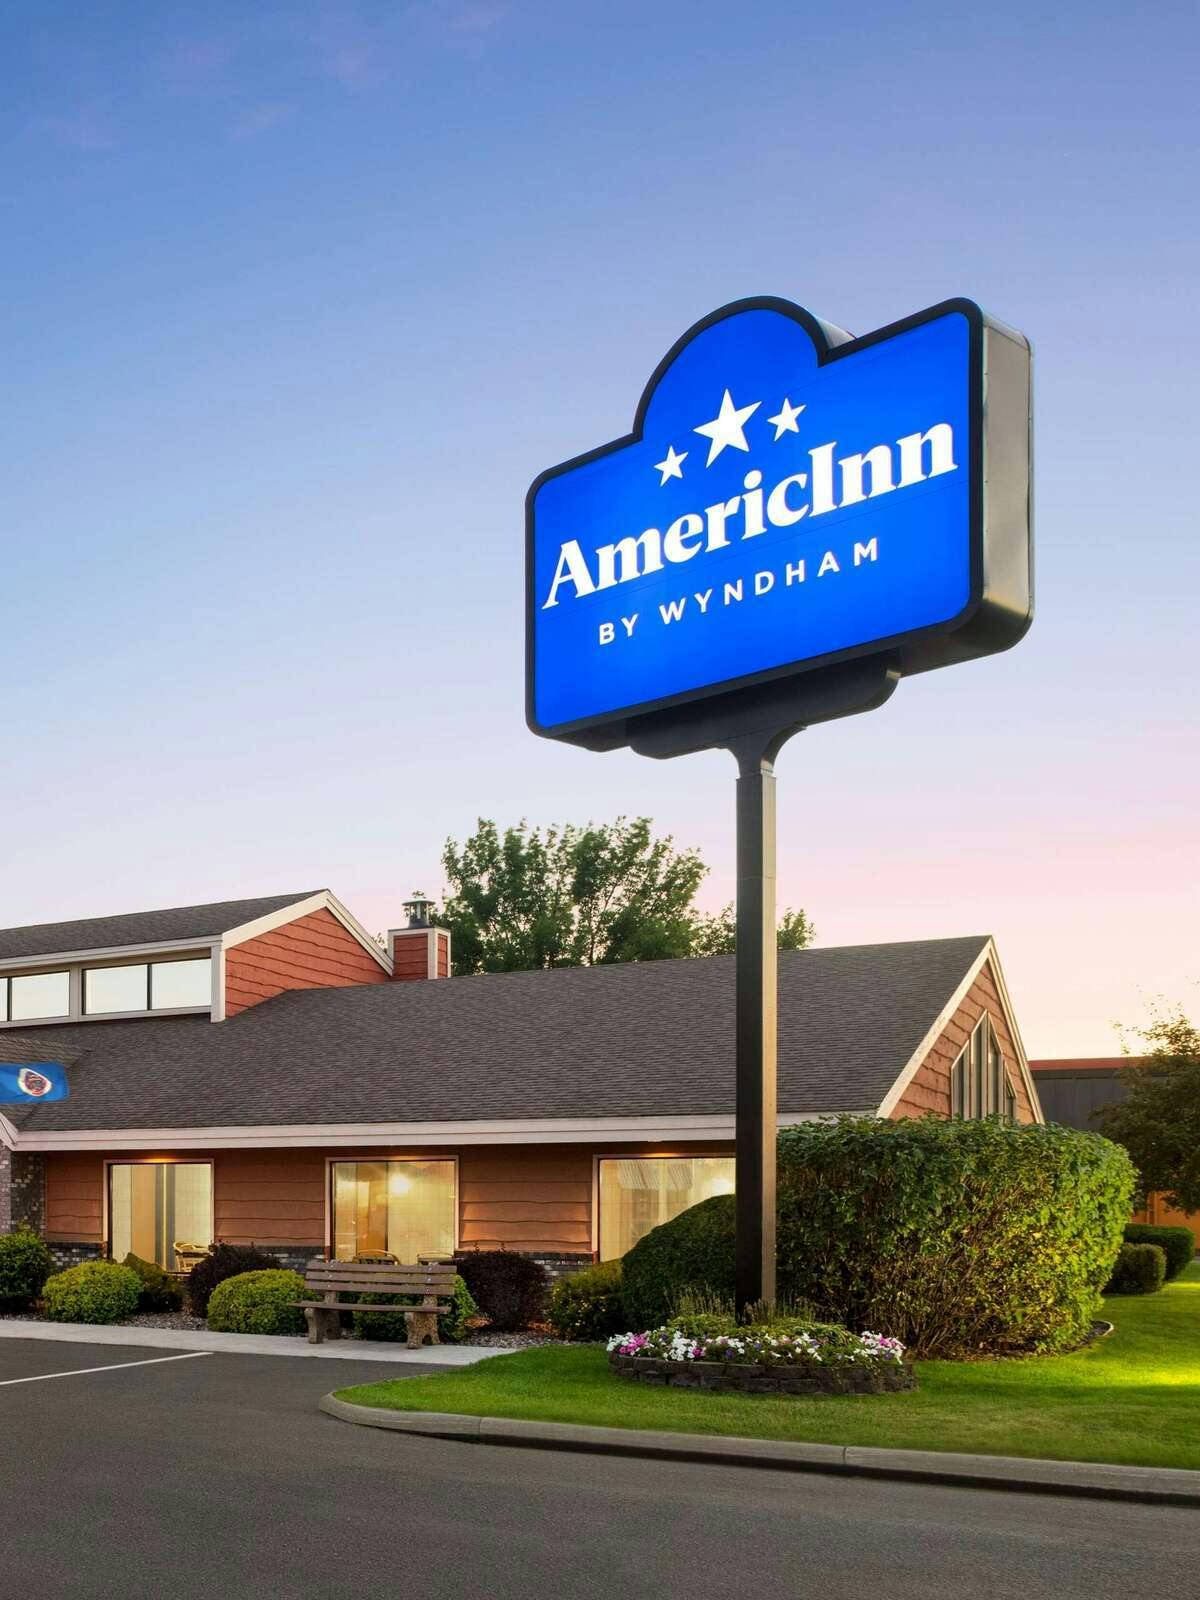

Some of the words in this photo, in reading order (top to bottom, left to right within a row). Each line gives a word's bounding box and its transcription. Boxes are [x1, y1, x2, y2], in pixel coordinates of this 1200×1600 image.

[542, 422, 958, 609] AmericInn
[599, 614, 638, 646] BY
[659, 537, 878, 625] WYNDHAM
